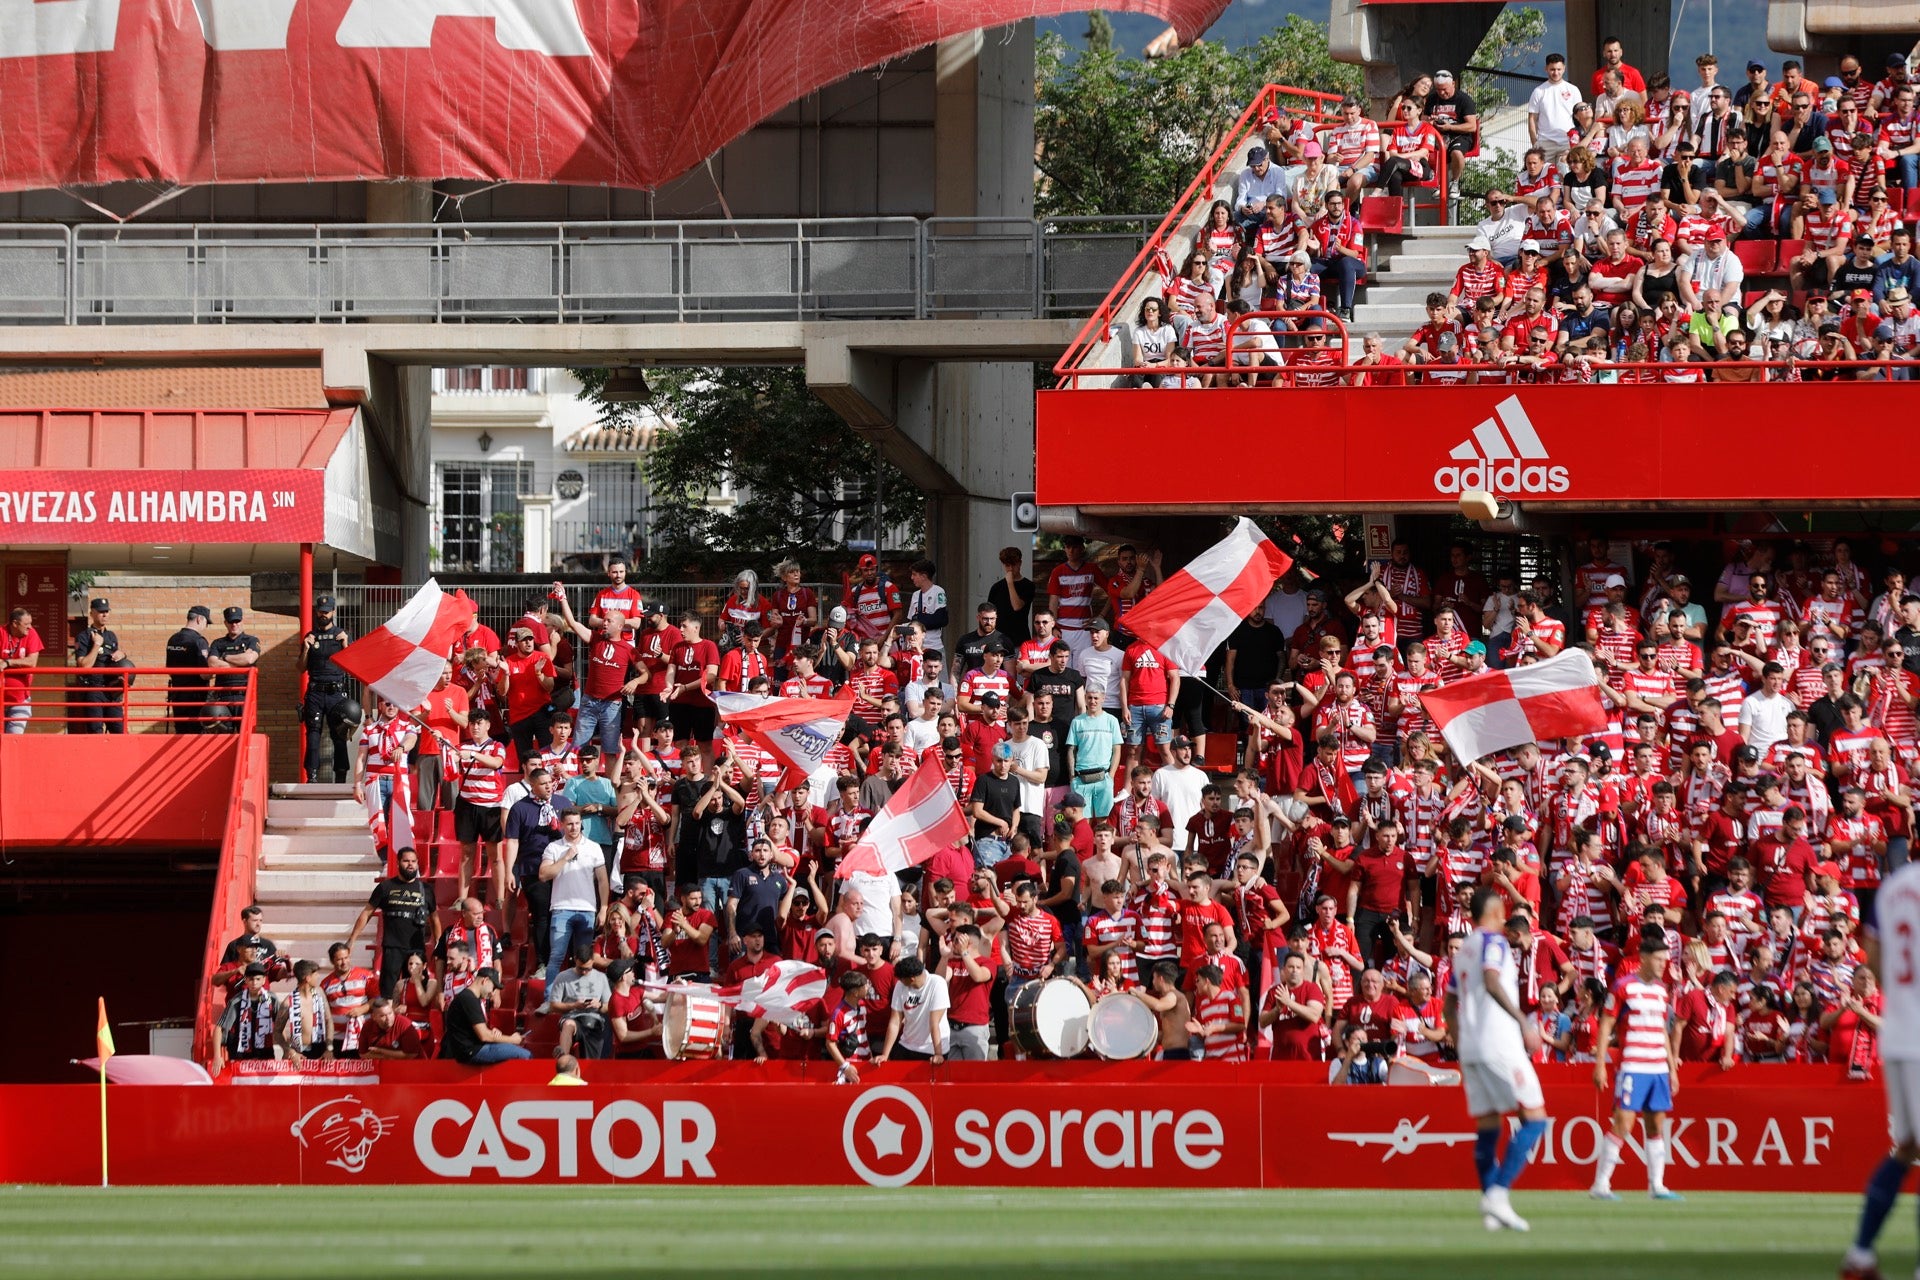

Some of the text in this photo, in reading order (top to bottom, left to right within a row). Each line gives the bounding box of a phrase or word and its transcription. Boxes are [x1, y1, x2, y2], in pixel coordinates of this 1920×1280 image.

[1143, 342, 1162, 353] 501
[1434, 457, 1570, 493] adidas
[0, 490, 296, 523] RVEZAS ALHAMBRA SIN
[1135, 661, 1160, 669] adidas
[240, 1060, 289, 1073] GRANADA
[321, 1059, 335, 1073] DE
[413, 1098, 717, 1178] CASTOR
[954, 1108, 1225, 1170] sorare
